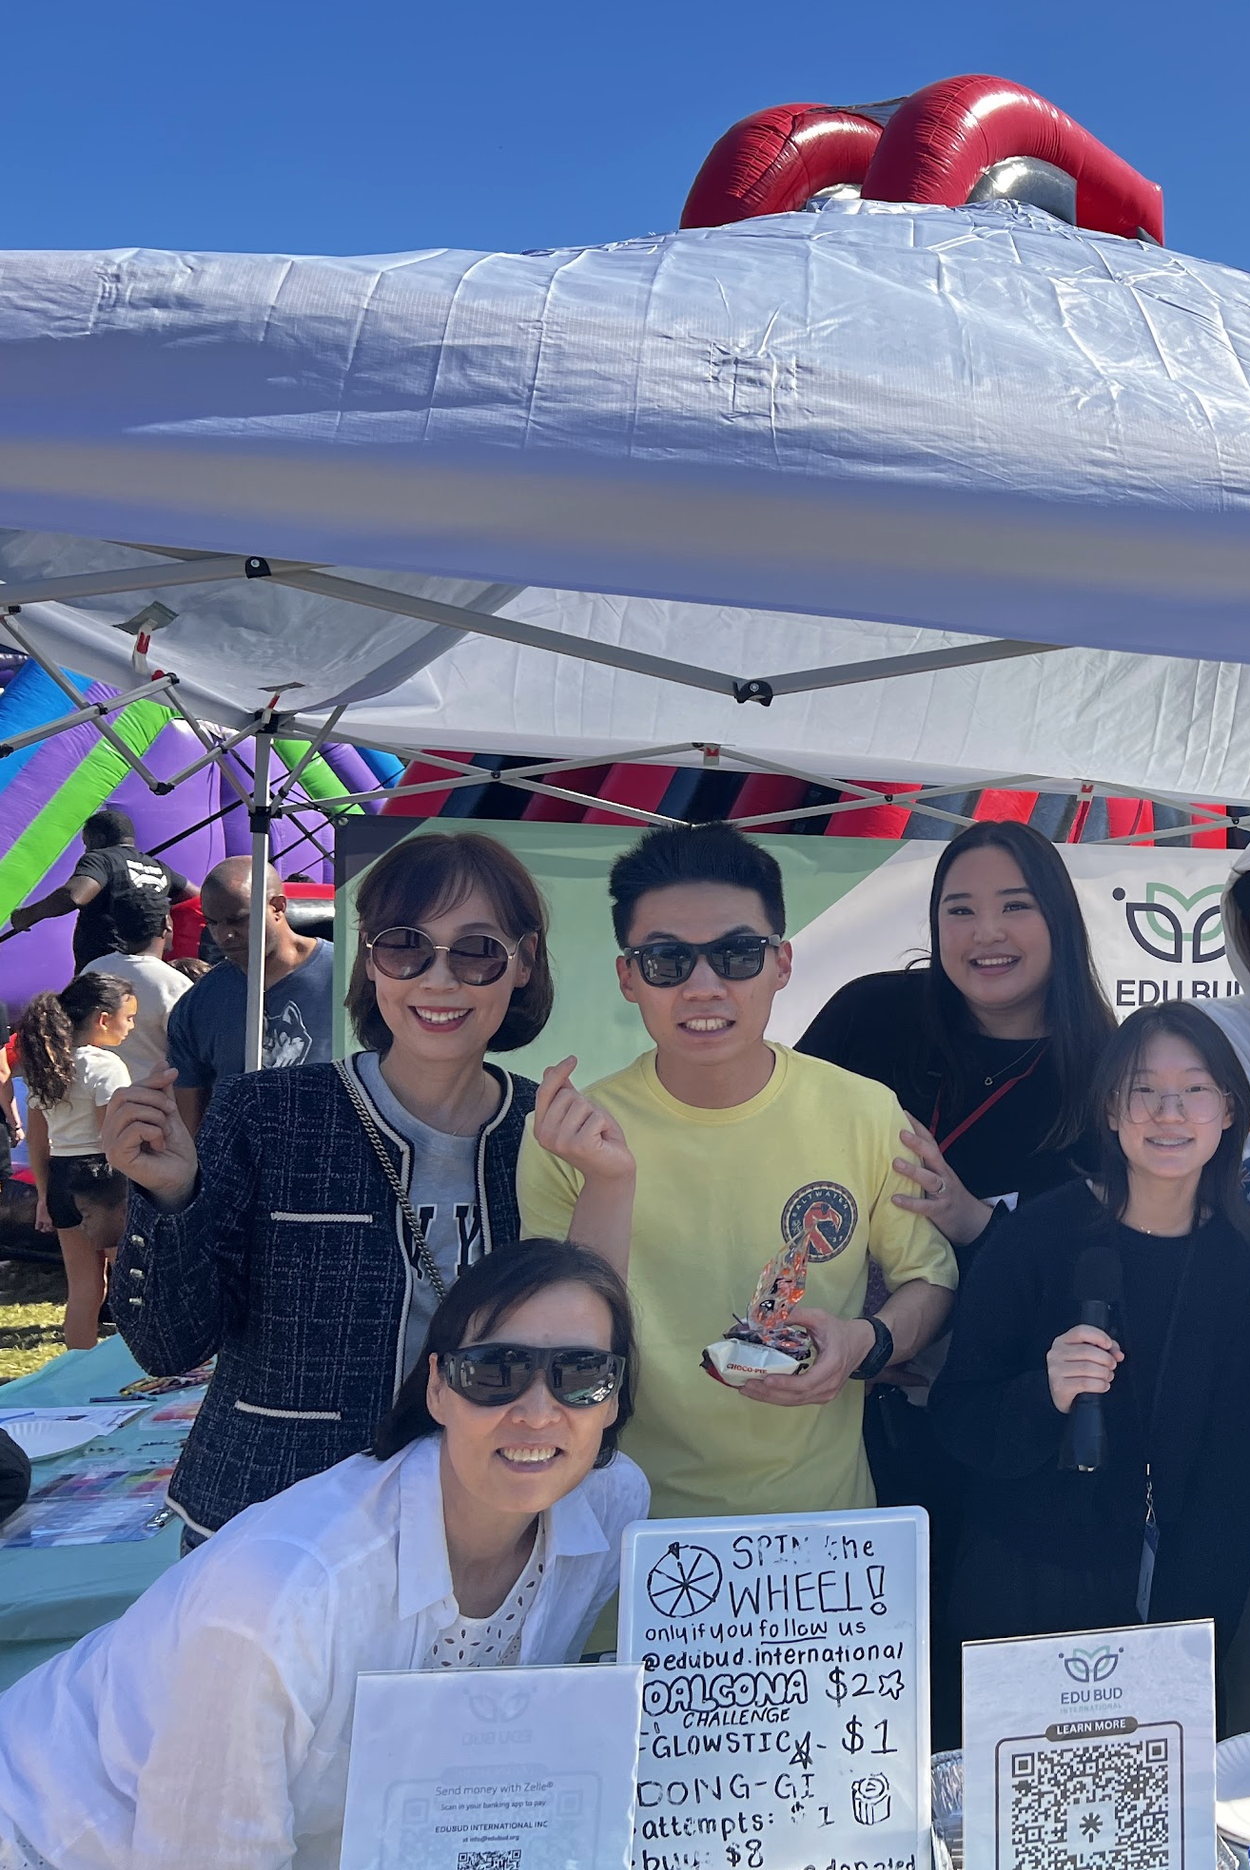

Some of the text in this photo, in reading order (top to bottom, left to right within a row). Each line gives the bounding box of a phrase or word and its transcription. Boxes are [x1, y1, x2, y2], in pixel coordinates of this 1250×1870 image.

[1116, 980, 1182, 1006] EDU
[729, 1565, 888, 1618] WHEEL!
[645, 1618, 866, 1645] only if you follow us
[825, 1666, 875, 1707] $2
[1061, 1687, 1123, 1705] EDU BUD
[683, 1707, 791, 1729] CHALLENGE
[1060, 1702, 1122, 1714] INTERNATIONAL
[842, 1715, 898, 1755] $1
[1056, 1719, 1126, 1735] LEARN MORE
[435, 1785, 461, 1797] Send
[463, 1785, 498, 1796] money
[500, 1782, 521, 1793] with
[440, 1803, 457, 1811] Scan
[466, 1803, 482, 1811] your
[483, 1801, 510, 1810] banking
[511, 1801, 524, 1809] app
[525, 1799, 533, 1807] to
[533, 1799, 547, 1807] pay
[435, 1820, 549, 1833] EDUBUD INTERNATIONAL INC
